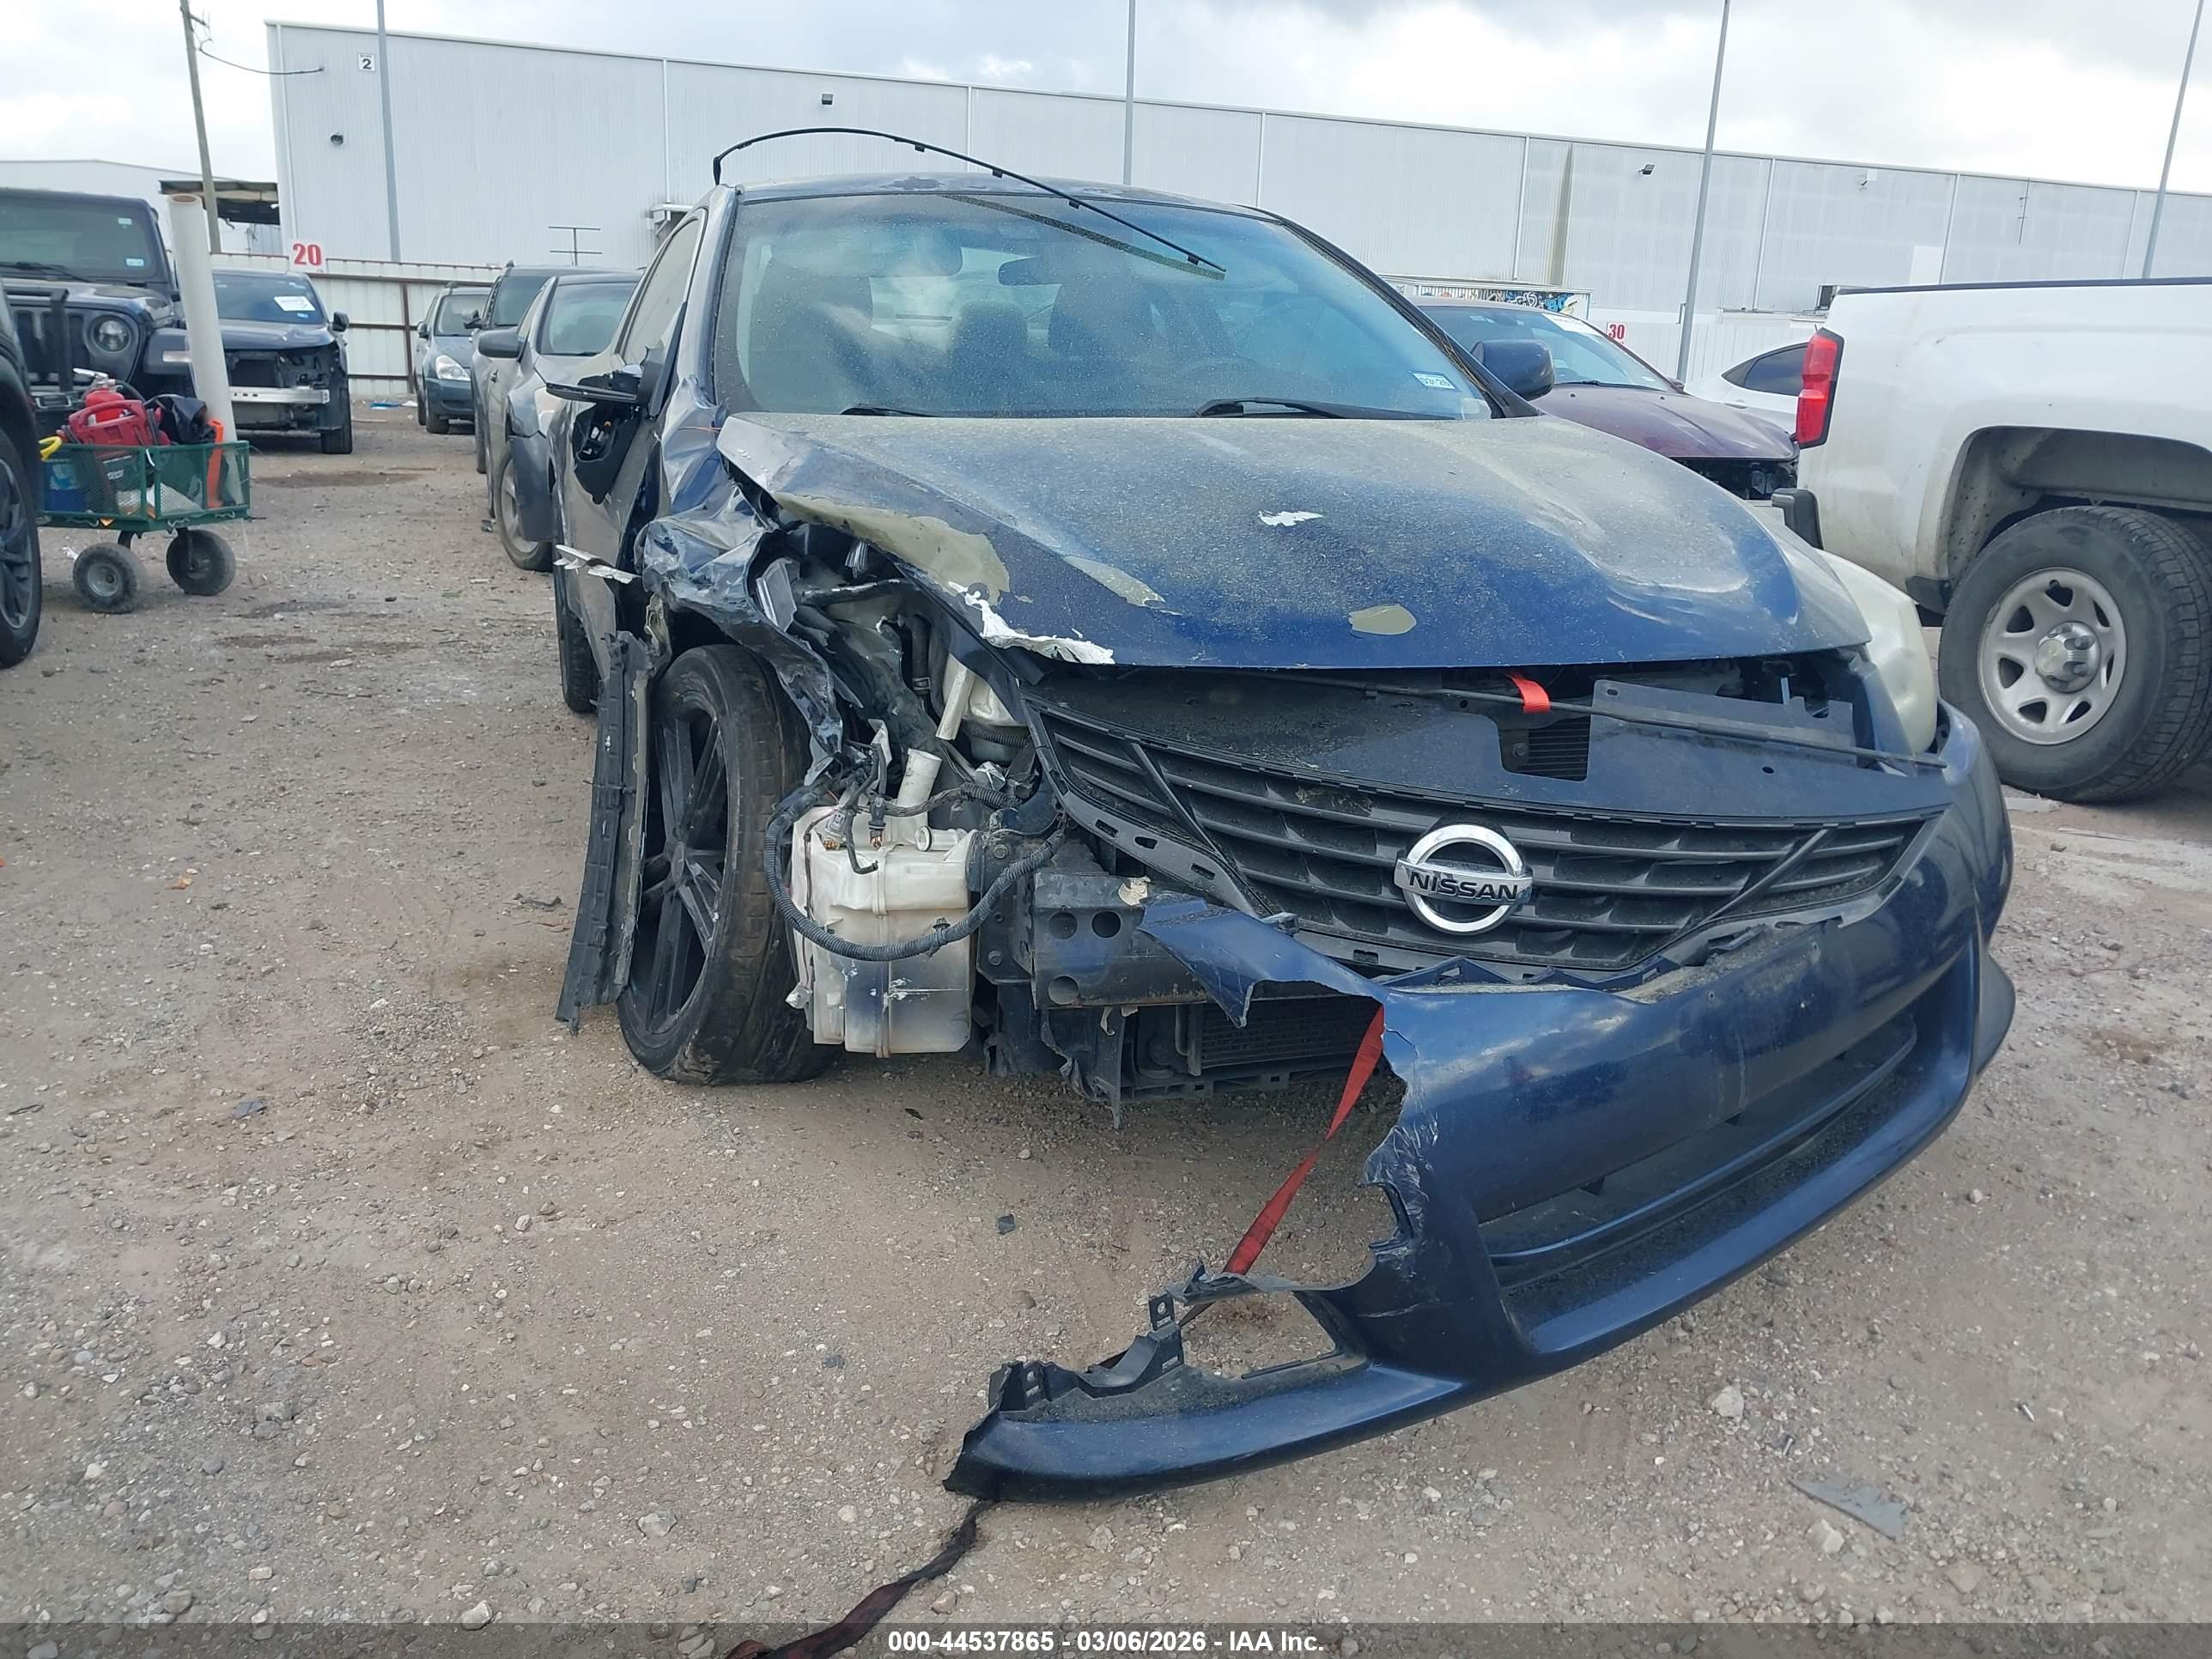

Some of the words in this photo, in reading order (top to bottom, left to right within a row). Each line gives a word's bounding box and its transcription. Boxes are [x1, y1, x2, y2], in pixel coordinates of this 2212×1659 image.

[362, 58, 372, 70] 2
[293, 243, 322, 266] 20
[1608, 324, 1626, 340] 30
[1409, 871, 1518, 900] NISSAN
